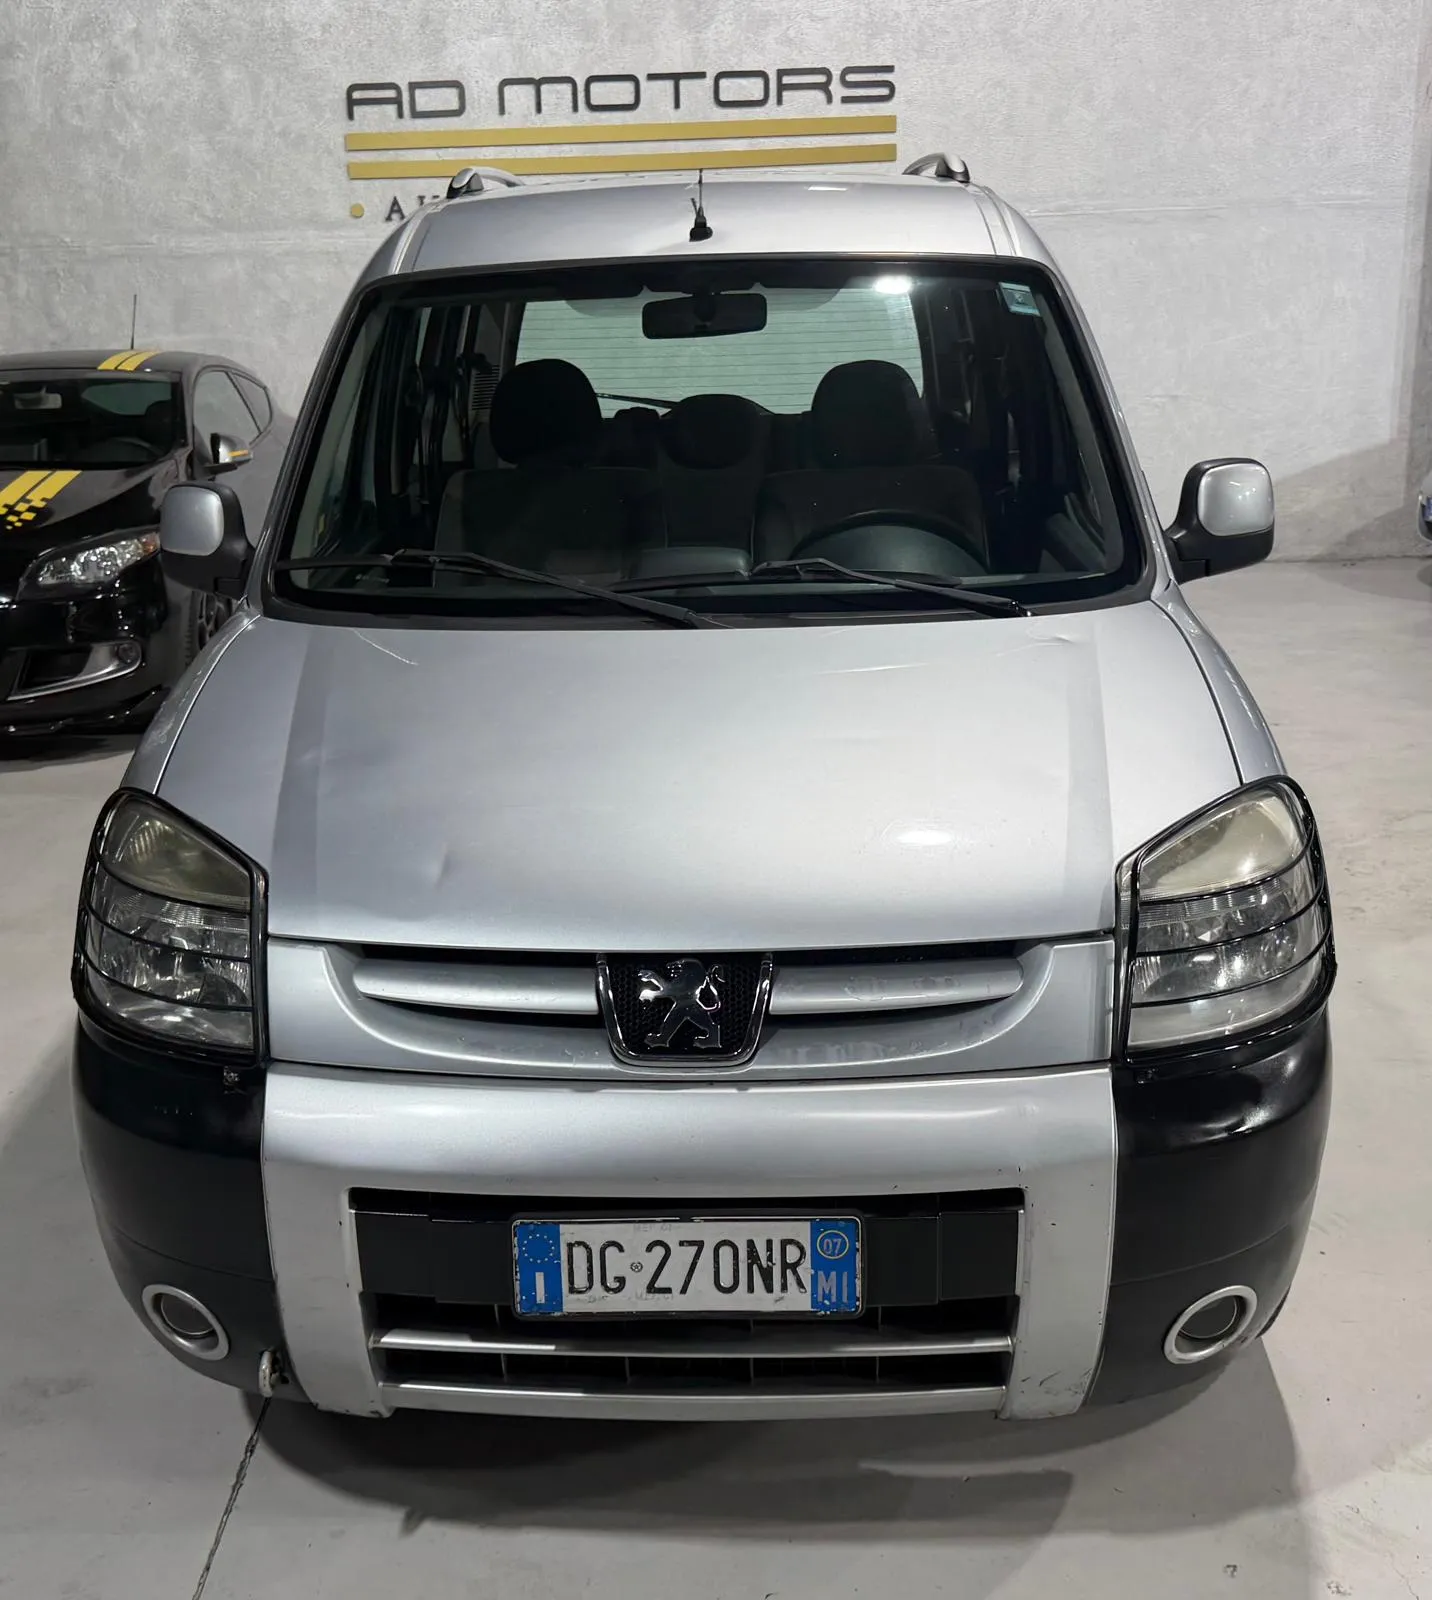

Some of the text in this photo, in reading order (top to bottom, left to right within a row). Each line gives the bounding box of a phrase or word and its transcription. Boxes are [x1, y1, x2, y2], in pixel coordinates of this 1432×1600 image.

[347, 65, 896, 120] AD MOTORS
[566, 1240, 626, 1294] DG
[823, 1238, 842, 1257] 07
[817, 1270, 849, 1303] MI
